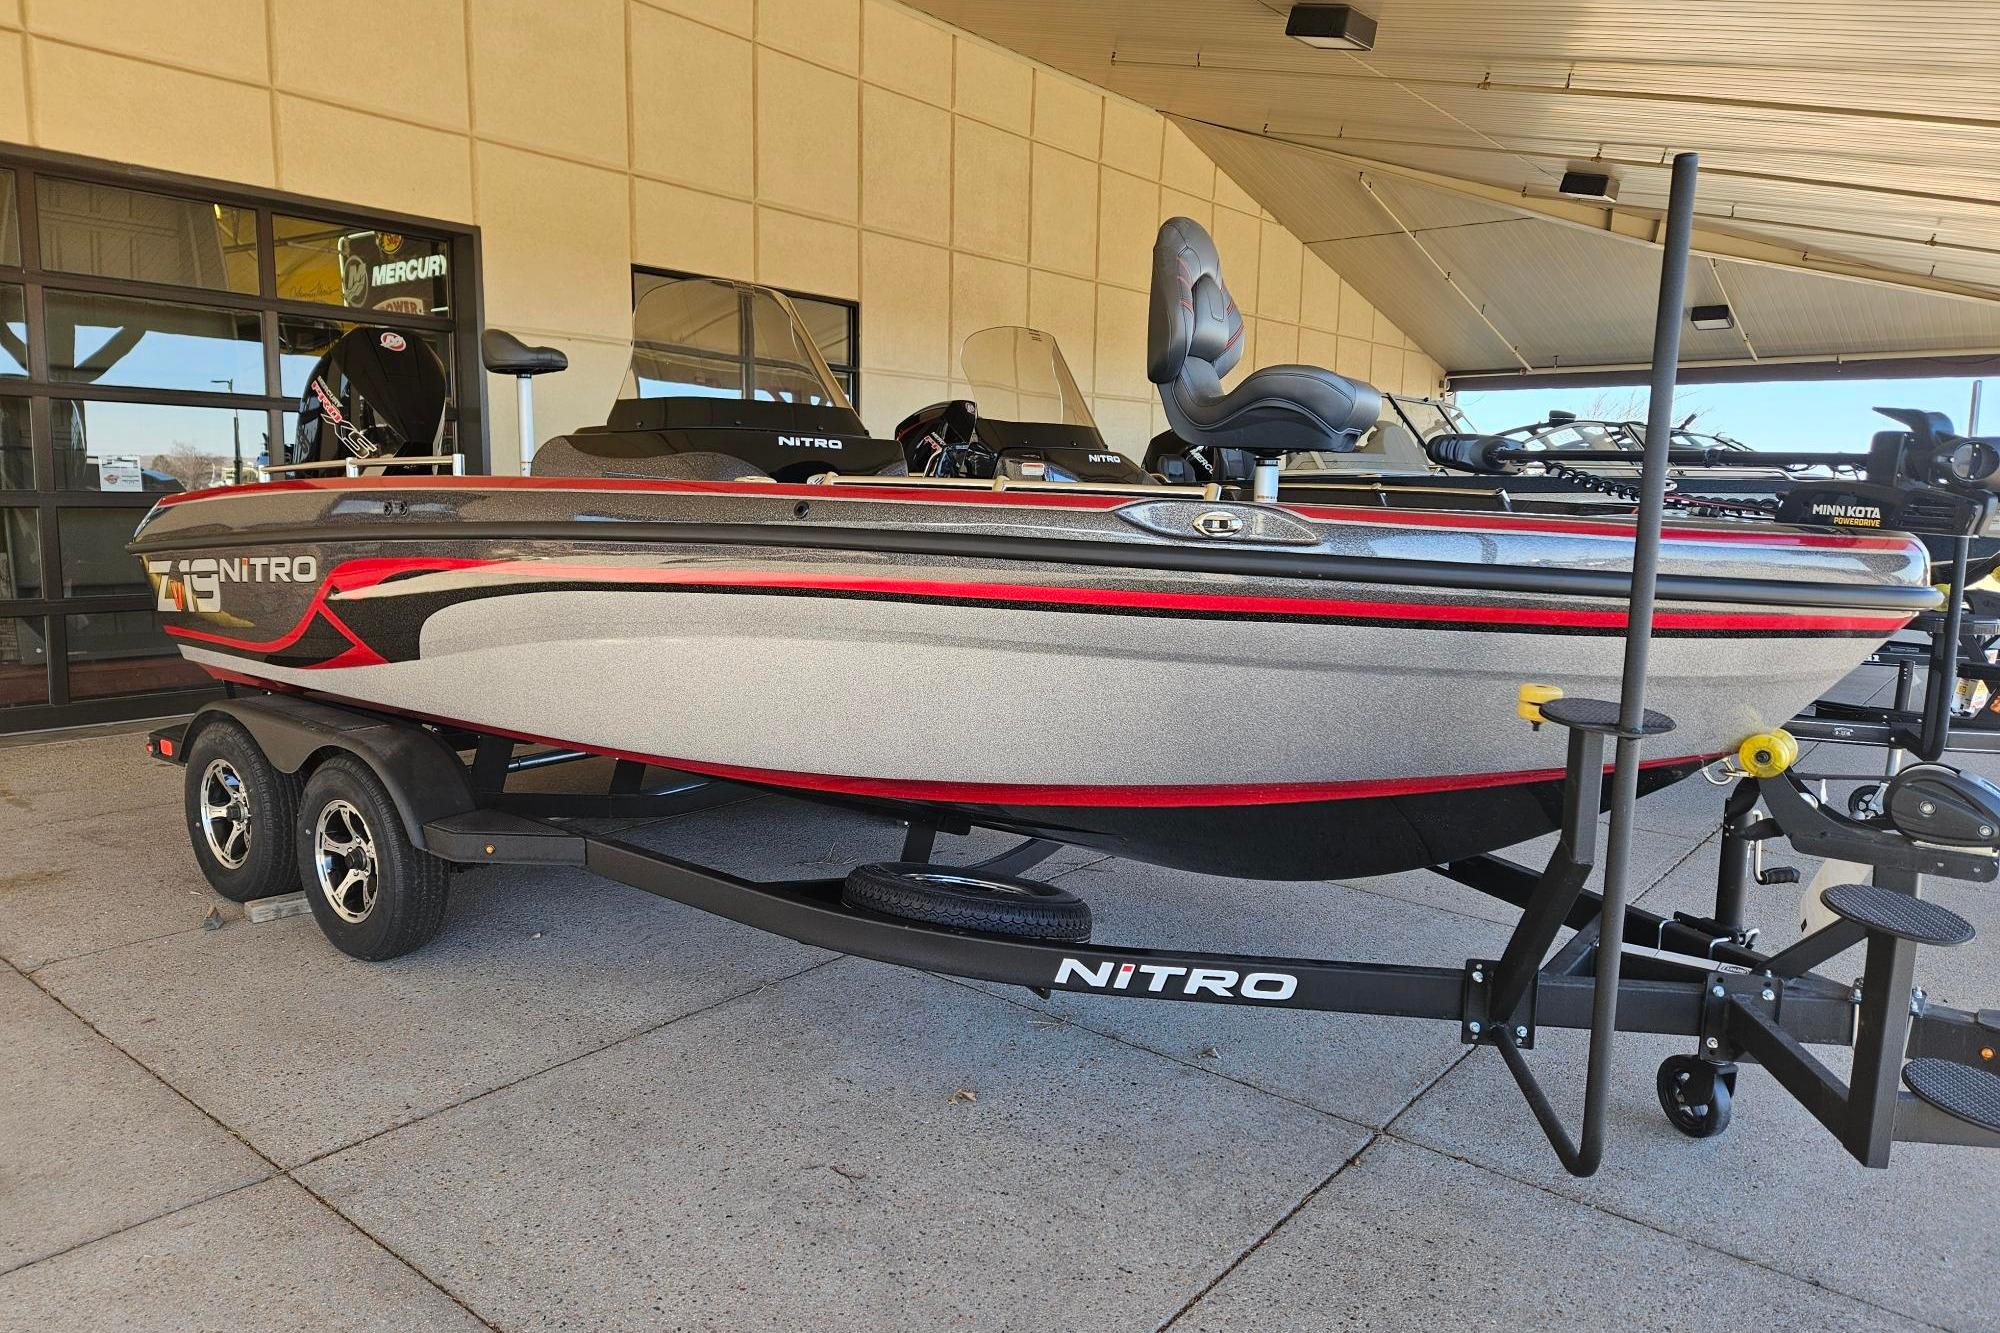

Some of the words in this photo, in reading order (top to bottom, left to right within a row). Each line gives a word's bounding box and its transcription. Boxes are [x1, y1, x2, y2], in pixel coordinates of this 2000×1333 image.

[371, 254, 447, 287] MERCURY
[778, 435, 843, 450] NITRO
[1088, 454, 1121, 463] NITRO
[1812, 504, 1846, 516] MINN
[1847, 506, 1881, 518] KOTA
[1833, 517, 1881, 527] POWERDRIVE
[219, 555, 317, 583] NITRO
[1054, 957, 1298, 1000] NITRO
